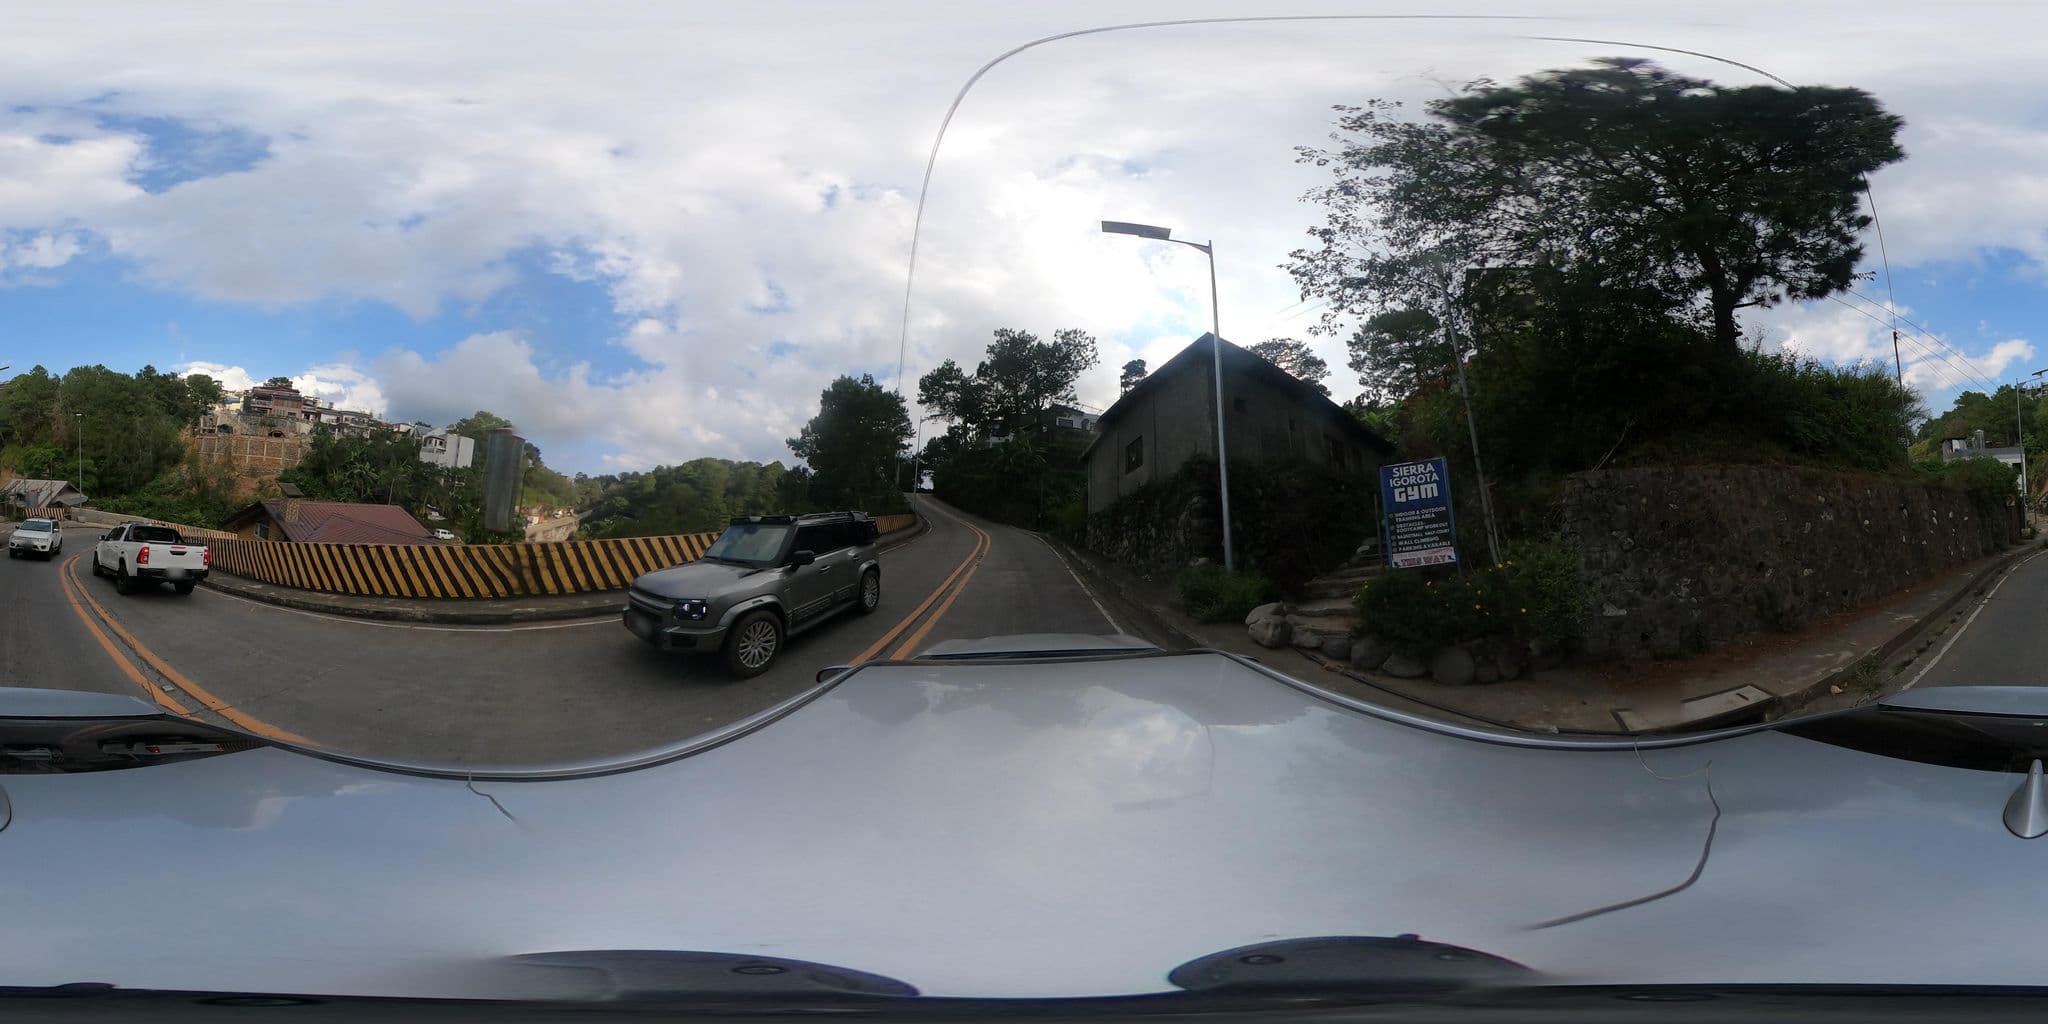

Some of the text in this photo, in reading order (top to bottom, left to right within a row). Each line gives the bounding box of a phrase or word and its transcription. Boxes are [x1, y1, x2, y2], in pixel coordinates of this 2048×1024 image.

[1393, 463, 1435, 477] SIERRA
[1389, 473, 1439, 487] IGOROTA
[1394, 483, 1438, 502] GYM
[1420, 506, 1446, 514] OUTDOOR
[1423, 541, 1451, 549] AVAAE
